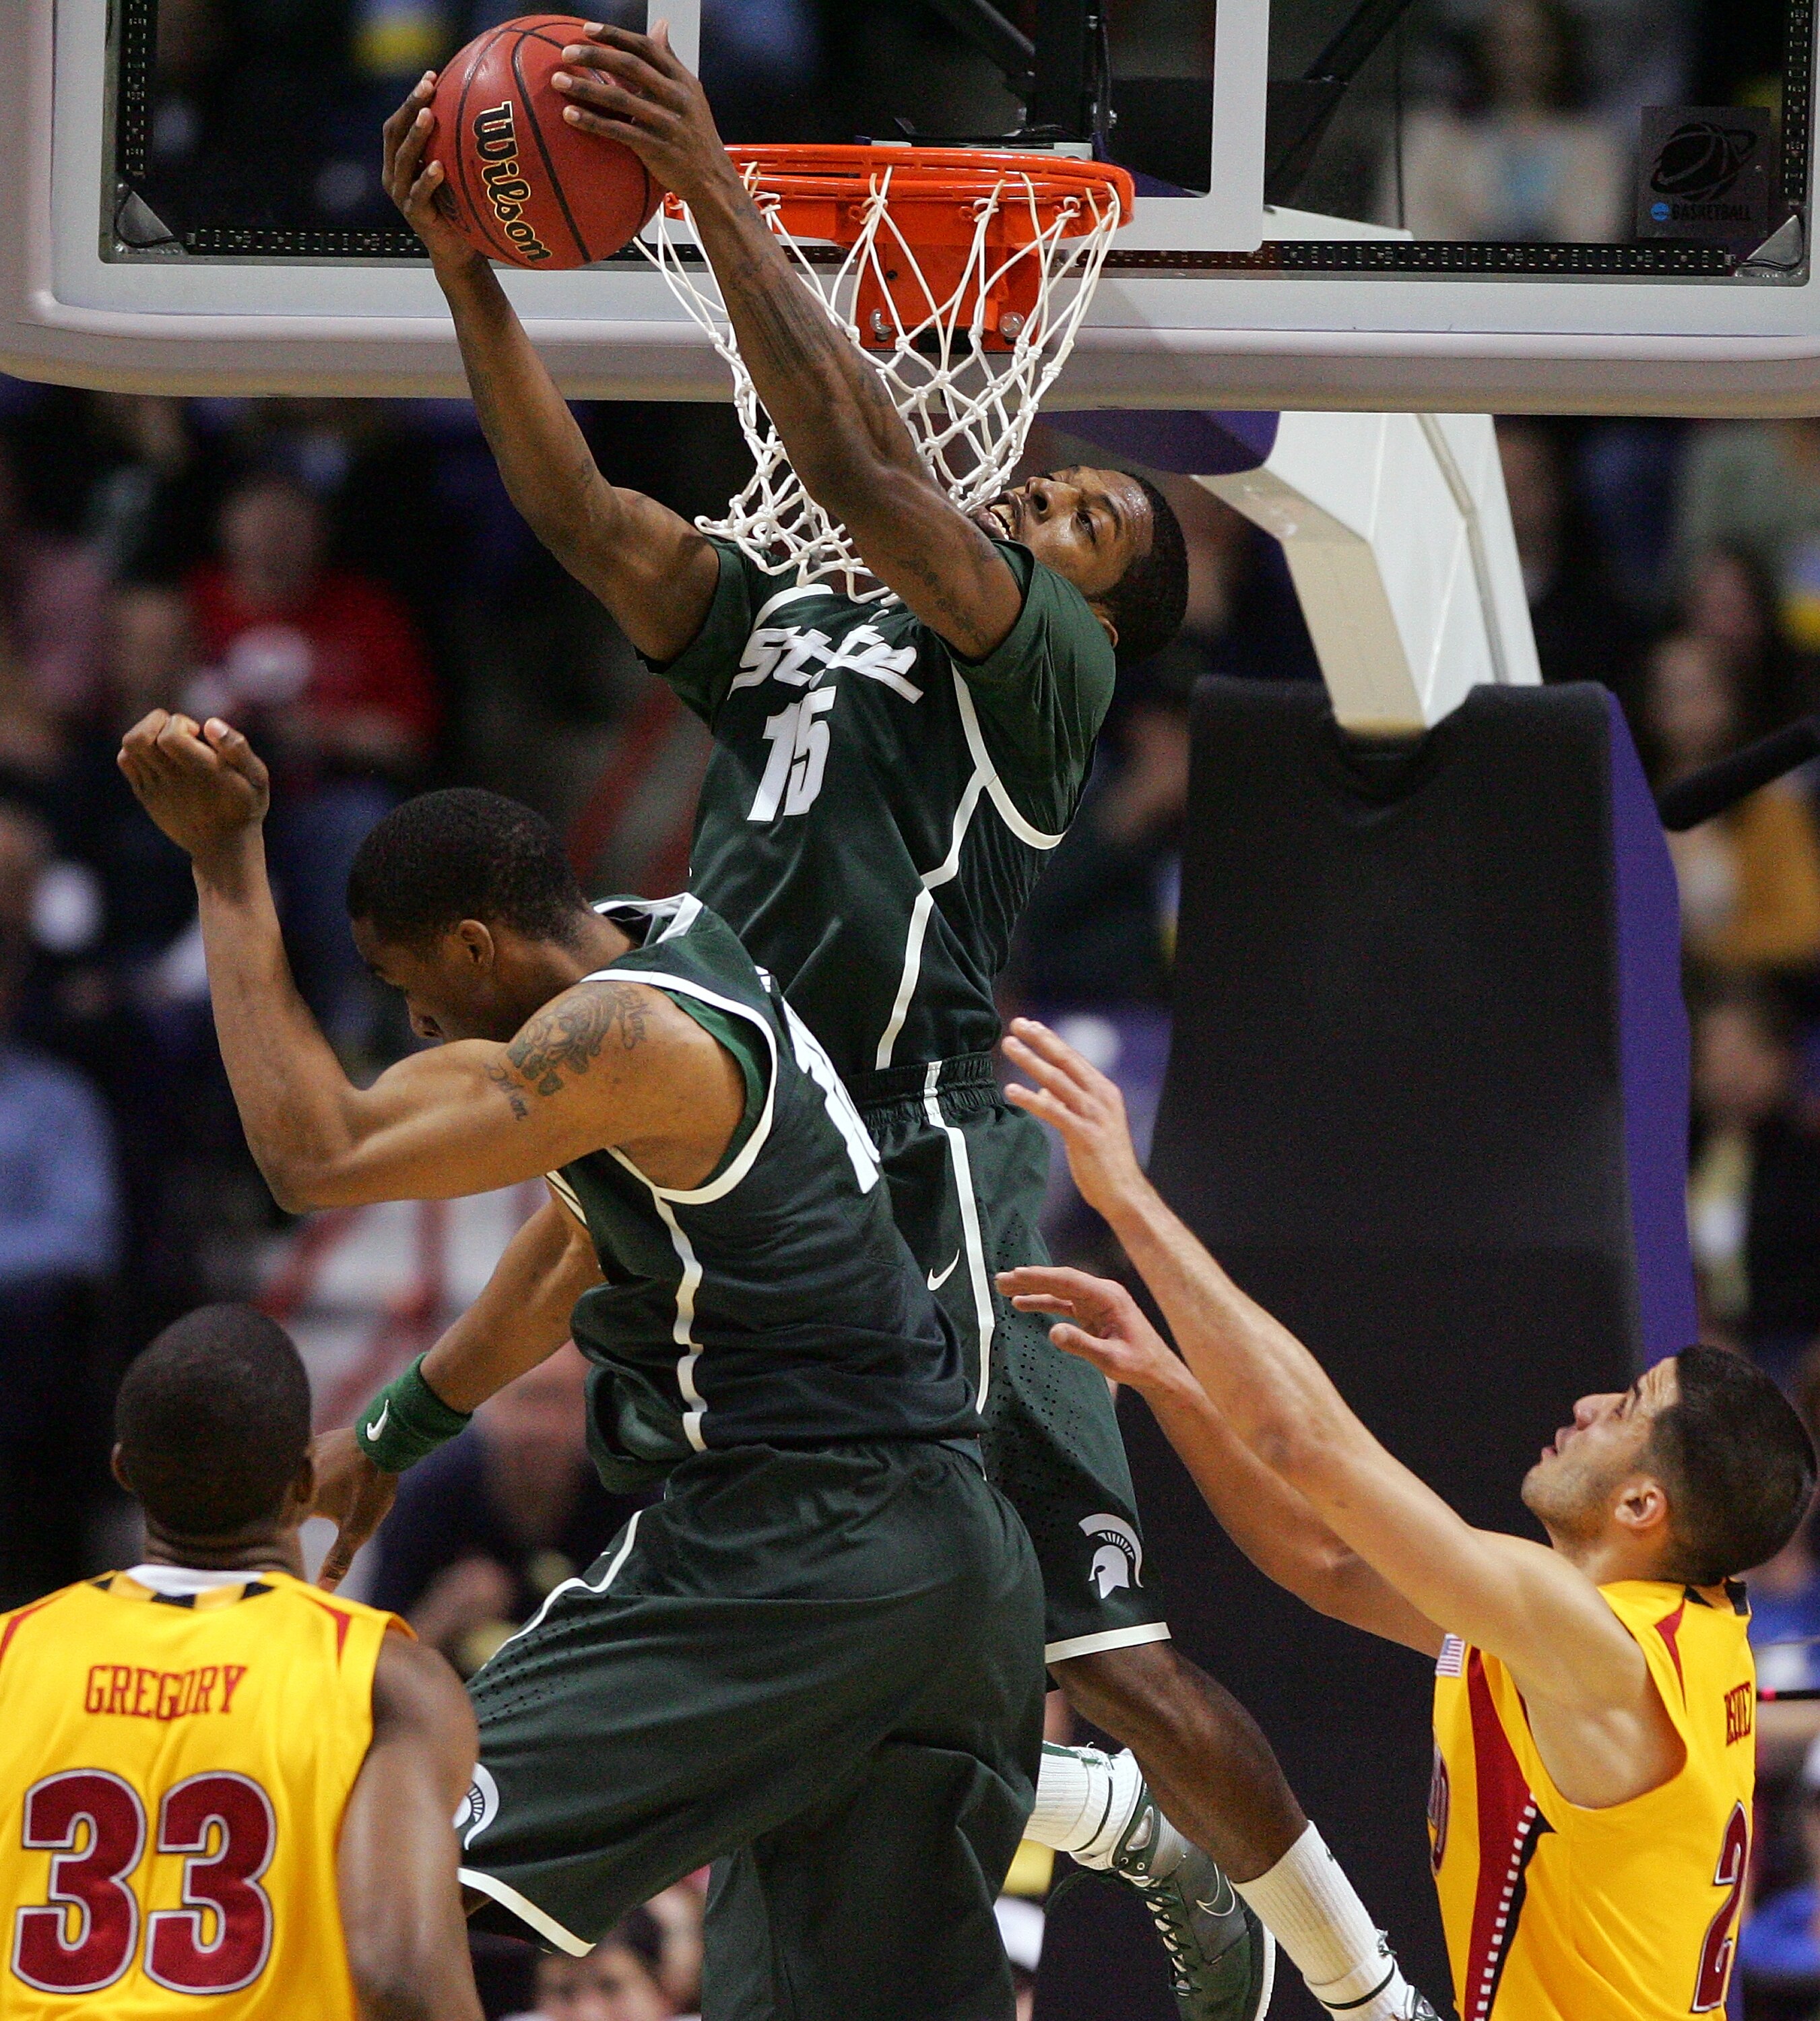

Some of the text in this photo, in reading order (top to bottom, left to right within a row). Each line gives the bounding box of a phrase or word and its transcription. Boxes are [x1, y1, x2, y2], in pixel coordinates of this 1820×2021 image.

[473, 100, 553, 263] Wilson
[1671, 203, 1751, 220] BASKETBALL
[746, 685, 837, 822] 15
[84, 1665, 247, 1721] GREGORY
[11, 1768, 277, 1995] 33
